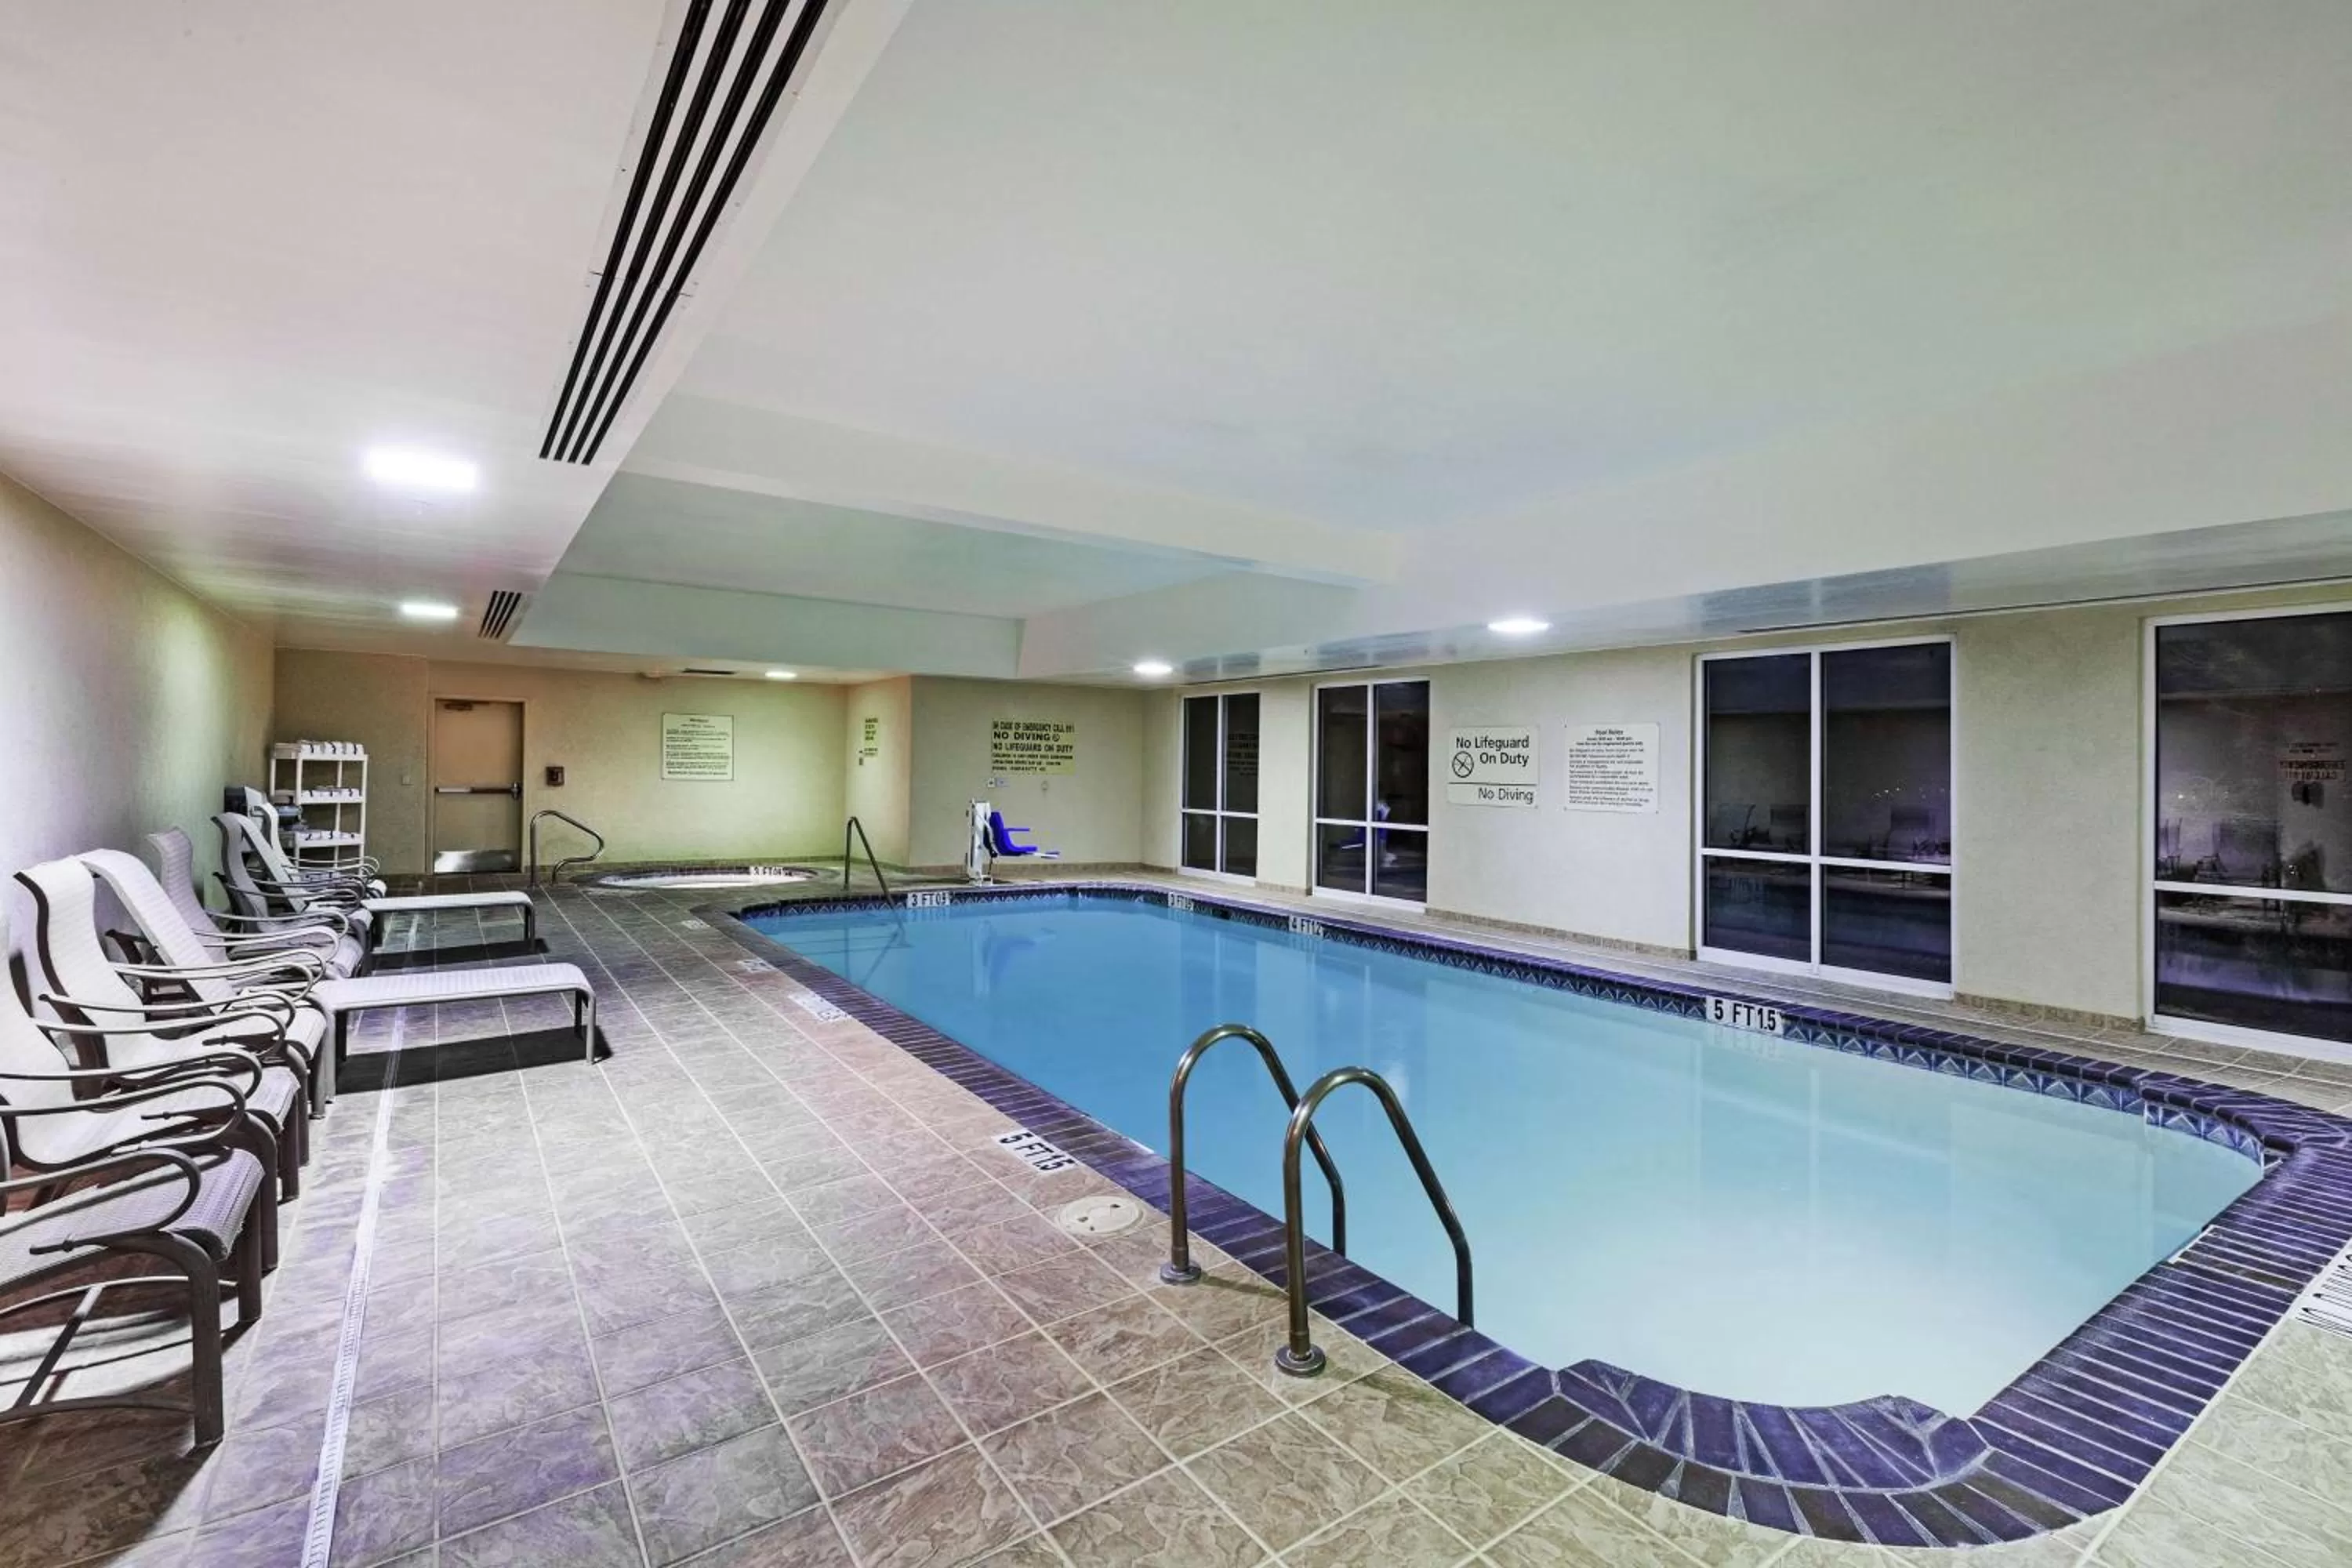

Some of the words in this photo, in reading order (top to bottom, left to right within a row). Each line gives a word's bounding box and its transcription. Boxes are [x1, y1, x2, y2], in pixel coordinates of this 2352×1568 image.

[1014, 731, 1051, 741] DIVING
[1005, 743, 1042, 752] LIFEGUARD
[1056, 745, 1073, 753] DUTY
[1456, 736, 1472, 749] No
[1475, 735, 1530, 752] Lifeguard
[1479, 752, 1497, 764] On
[1500, 752, 1530, 768] Duty
[1478, 786, 1494, 800] No
[1498, 787, 1534, 804] Diving
[911, 893, 918, 906] 3
[1714, 999, 1724, 1020] 5
[999, 1132, 1033, 1144] 5
